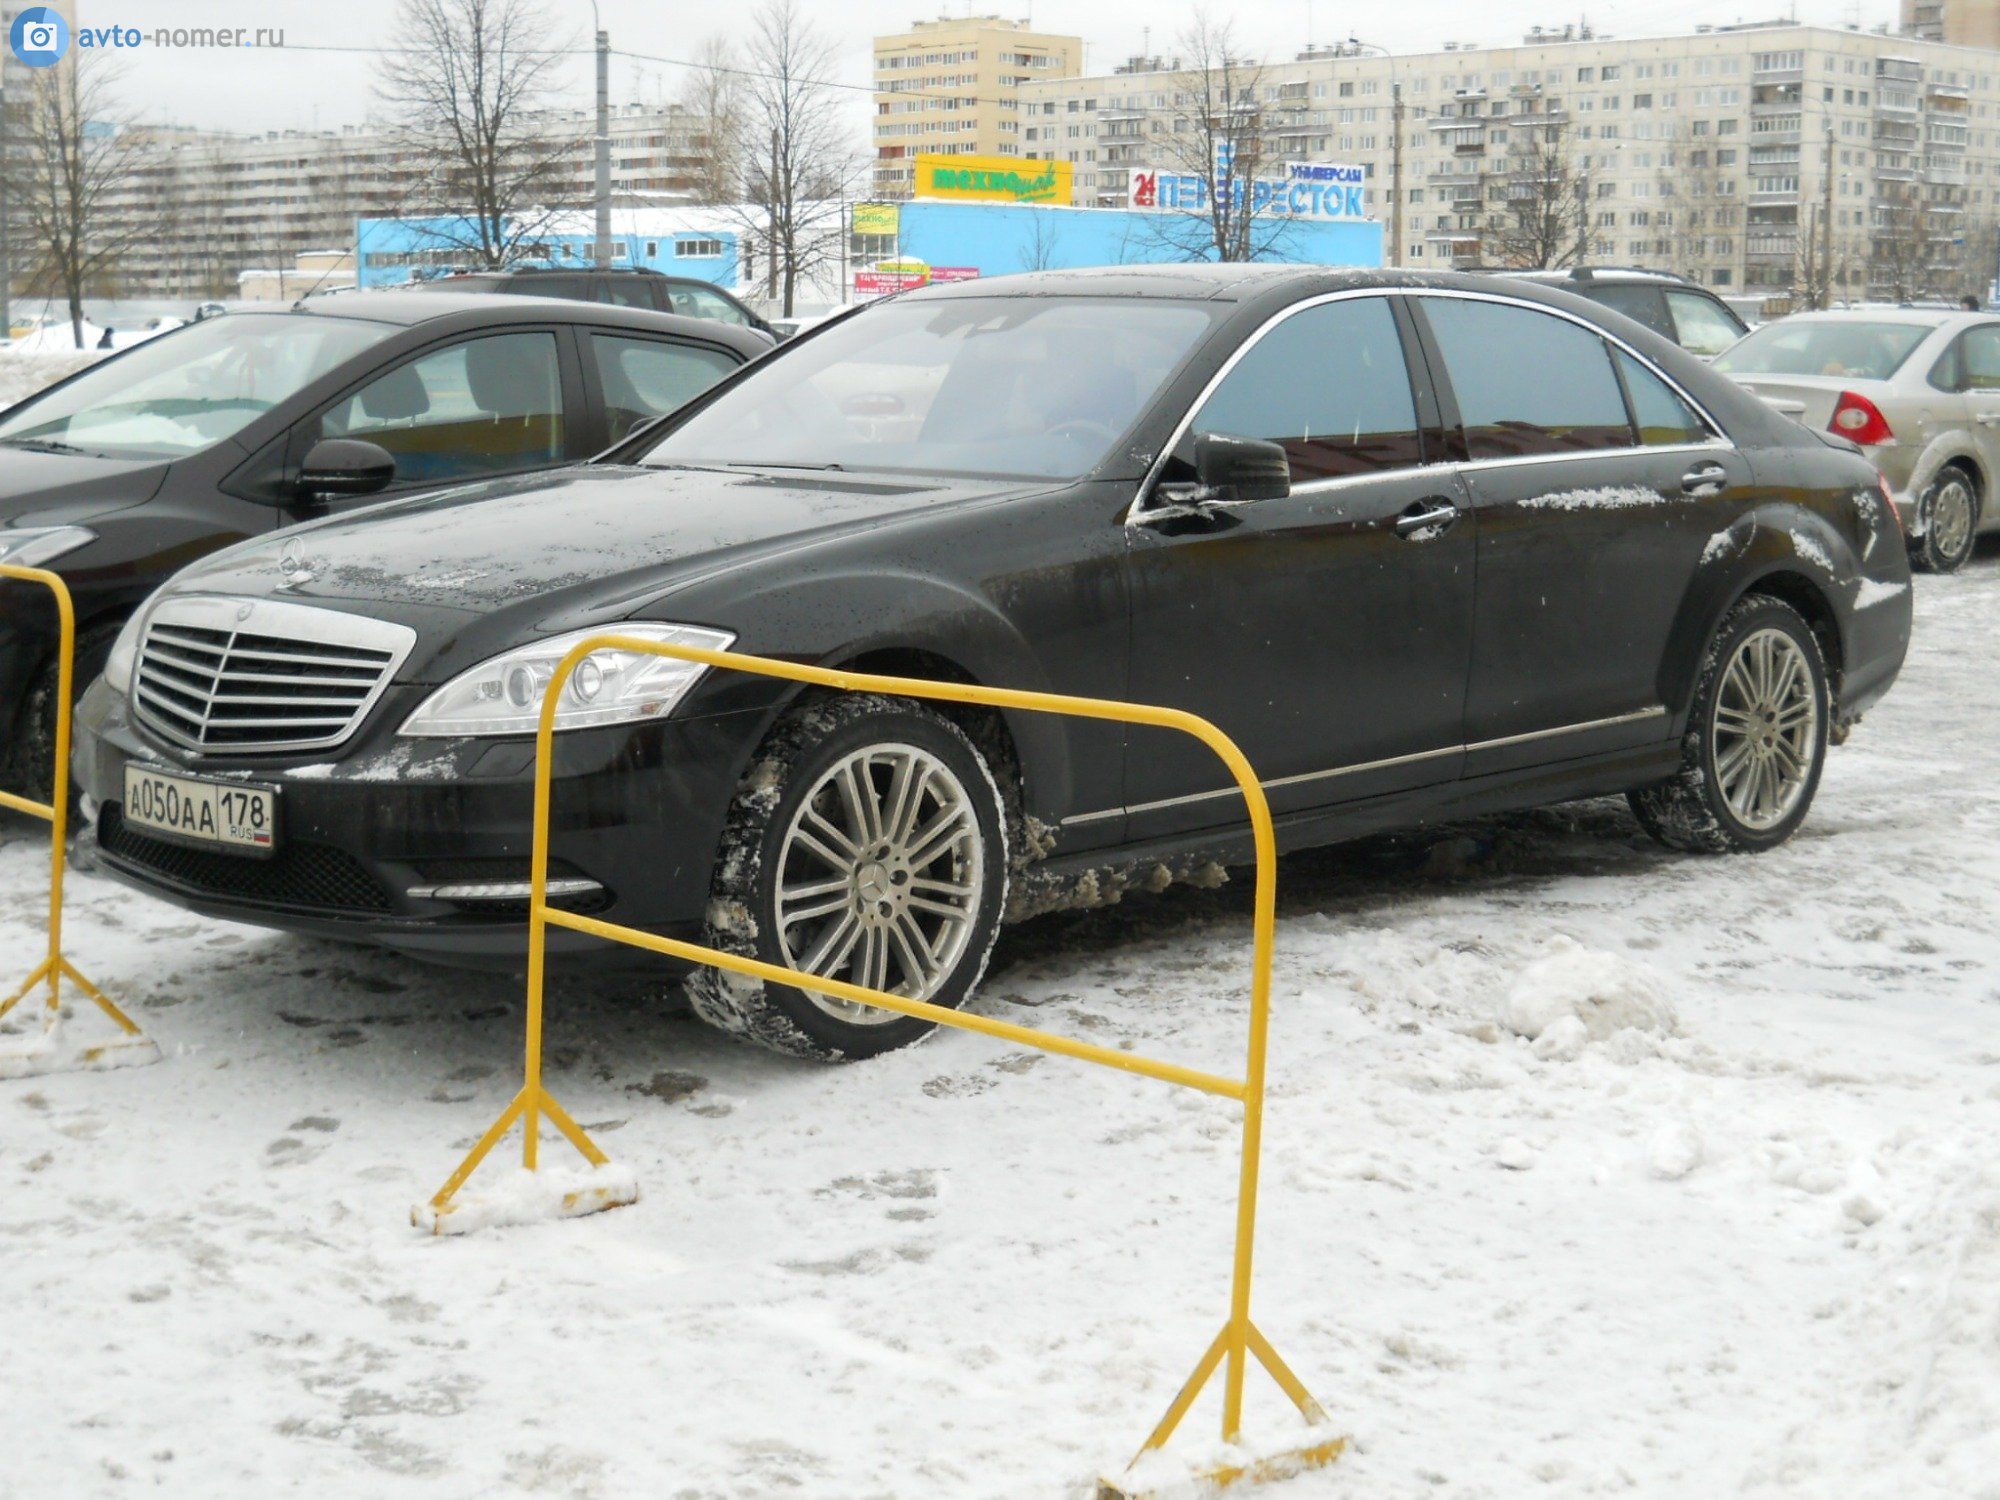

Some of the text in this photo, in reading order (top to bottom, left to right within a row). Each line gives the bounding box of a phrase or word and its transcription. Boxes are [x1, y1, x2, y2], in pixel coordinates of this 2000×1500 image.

[1290, 165, 1362, 182] УНИВЕРСАМ
[221, 791, 264, 828] 178
[230, 826, 253, 840] RUS
